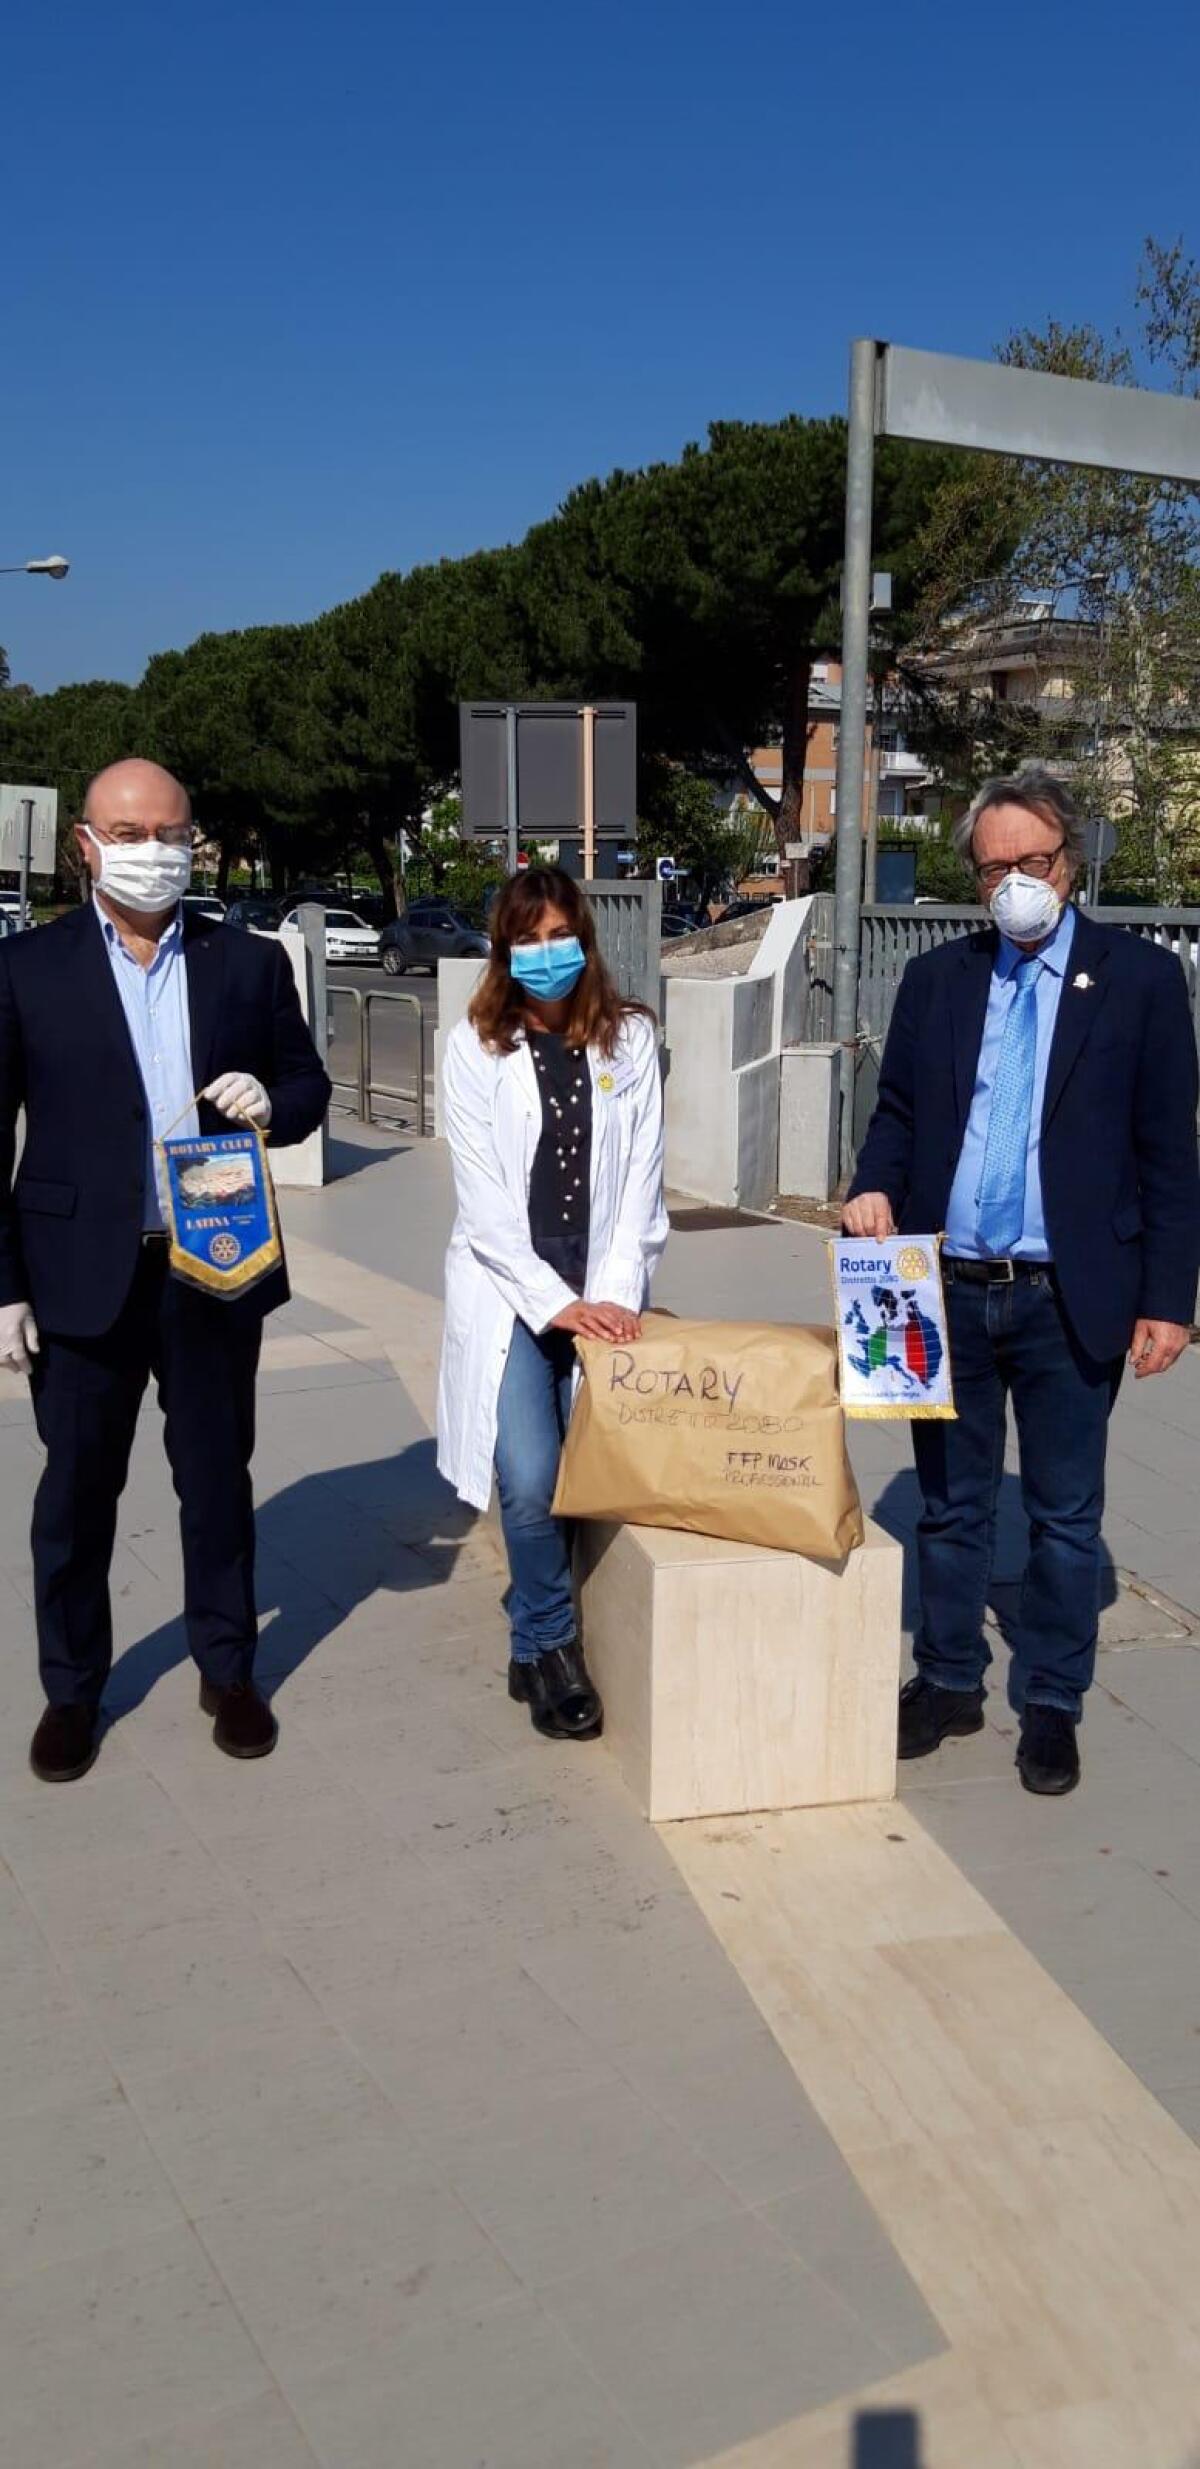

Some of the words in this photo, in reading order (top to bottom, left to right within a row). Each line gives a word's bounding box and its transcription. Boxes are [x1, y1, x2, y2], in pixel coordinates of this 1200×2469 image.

[169, 1142, 217, 1156] ROTARY
[221, 1138, 253, 1151] CLUB
[186, 1216, 230, 1231] LATINA
[840, 1257, 892, 1275] Rotary
[609, 1350, 743, 1412] ROTARY
[726, 1412, 804, 1434] 2080
[768, 1453, 813, 1471] MASK
